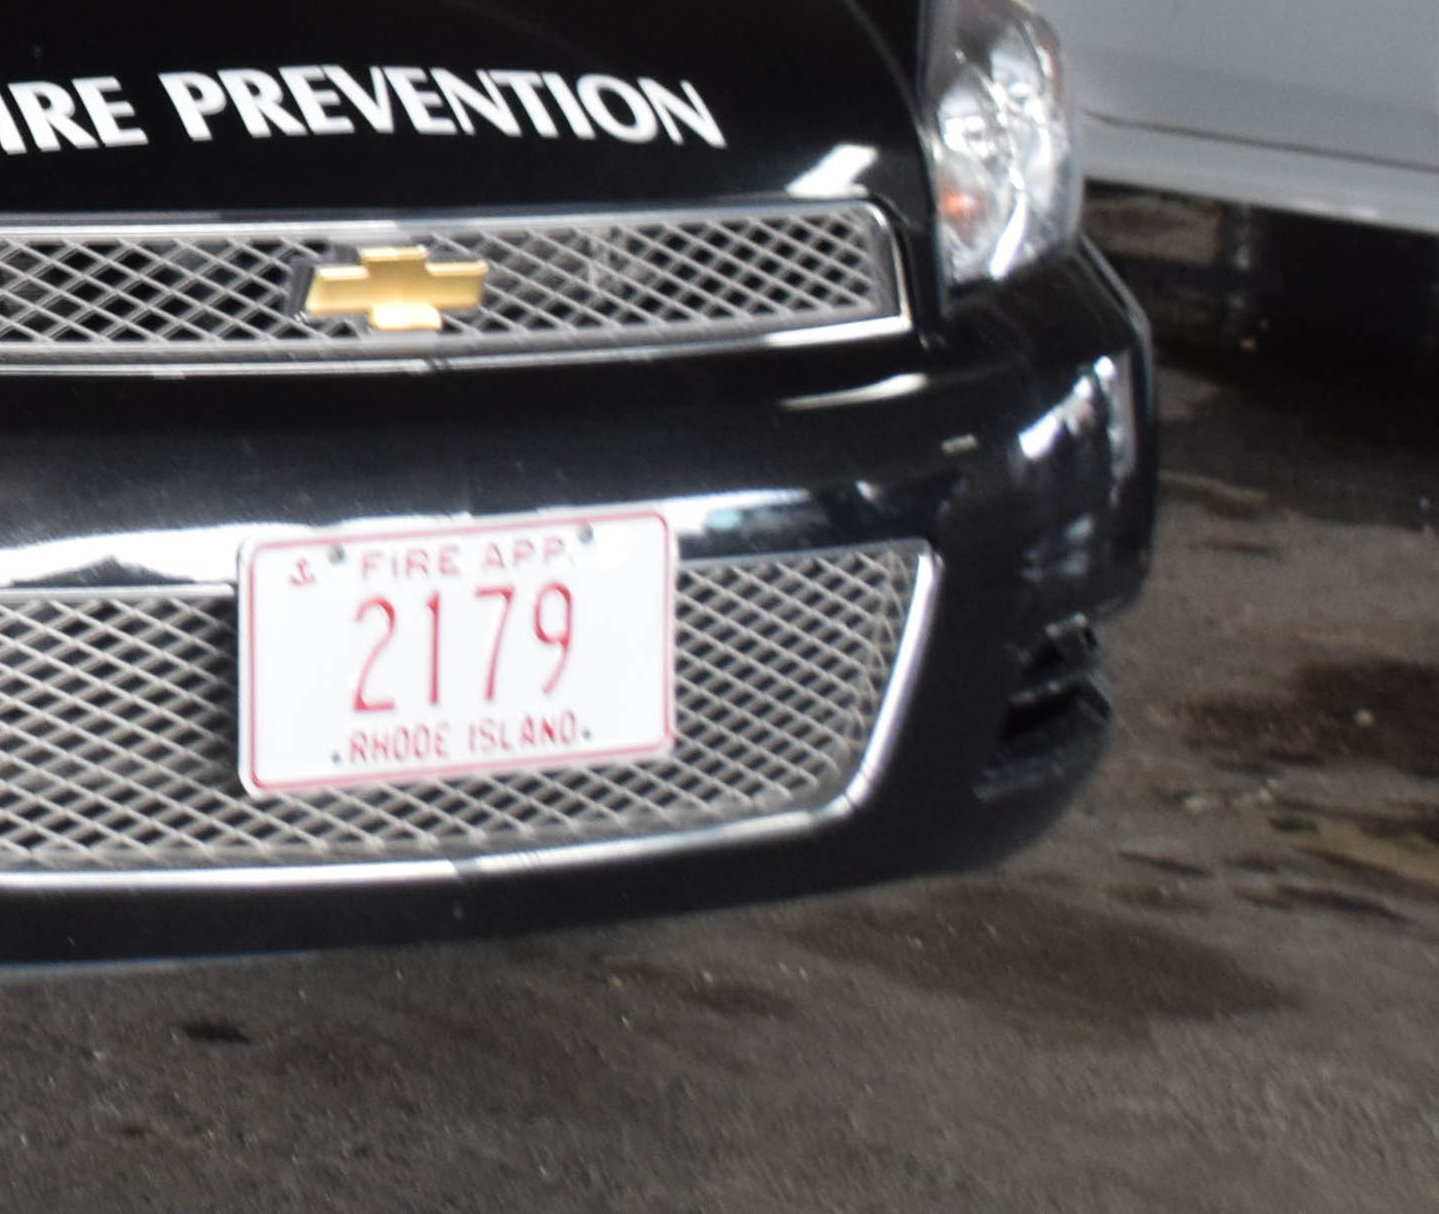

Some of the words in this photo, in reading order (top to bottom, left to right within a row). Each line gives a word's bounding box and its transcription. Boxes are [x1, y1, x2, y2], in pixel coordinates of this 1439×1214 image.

[158, 64, 727, 149] PREVENTION
[360, 543, 461, 579] FIRE
[353, 581, 574, 713] 2179
[349, 724, 448, 764] RHODE
[468, 711, 578, 753] ISLAND
